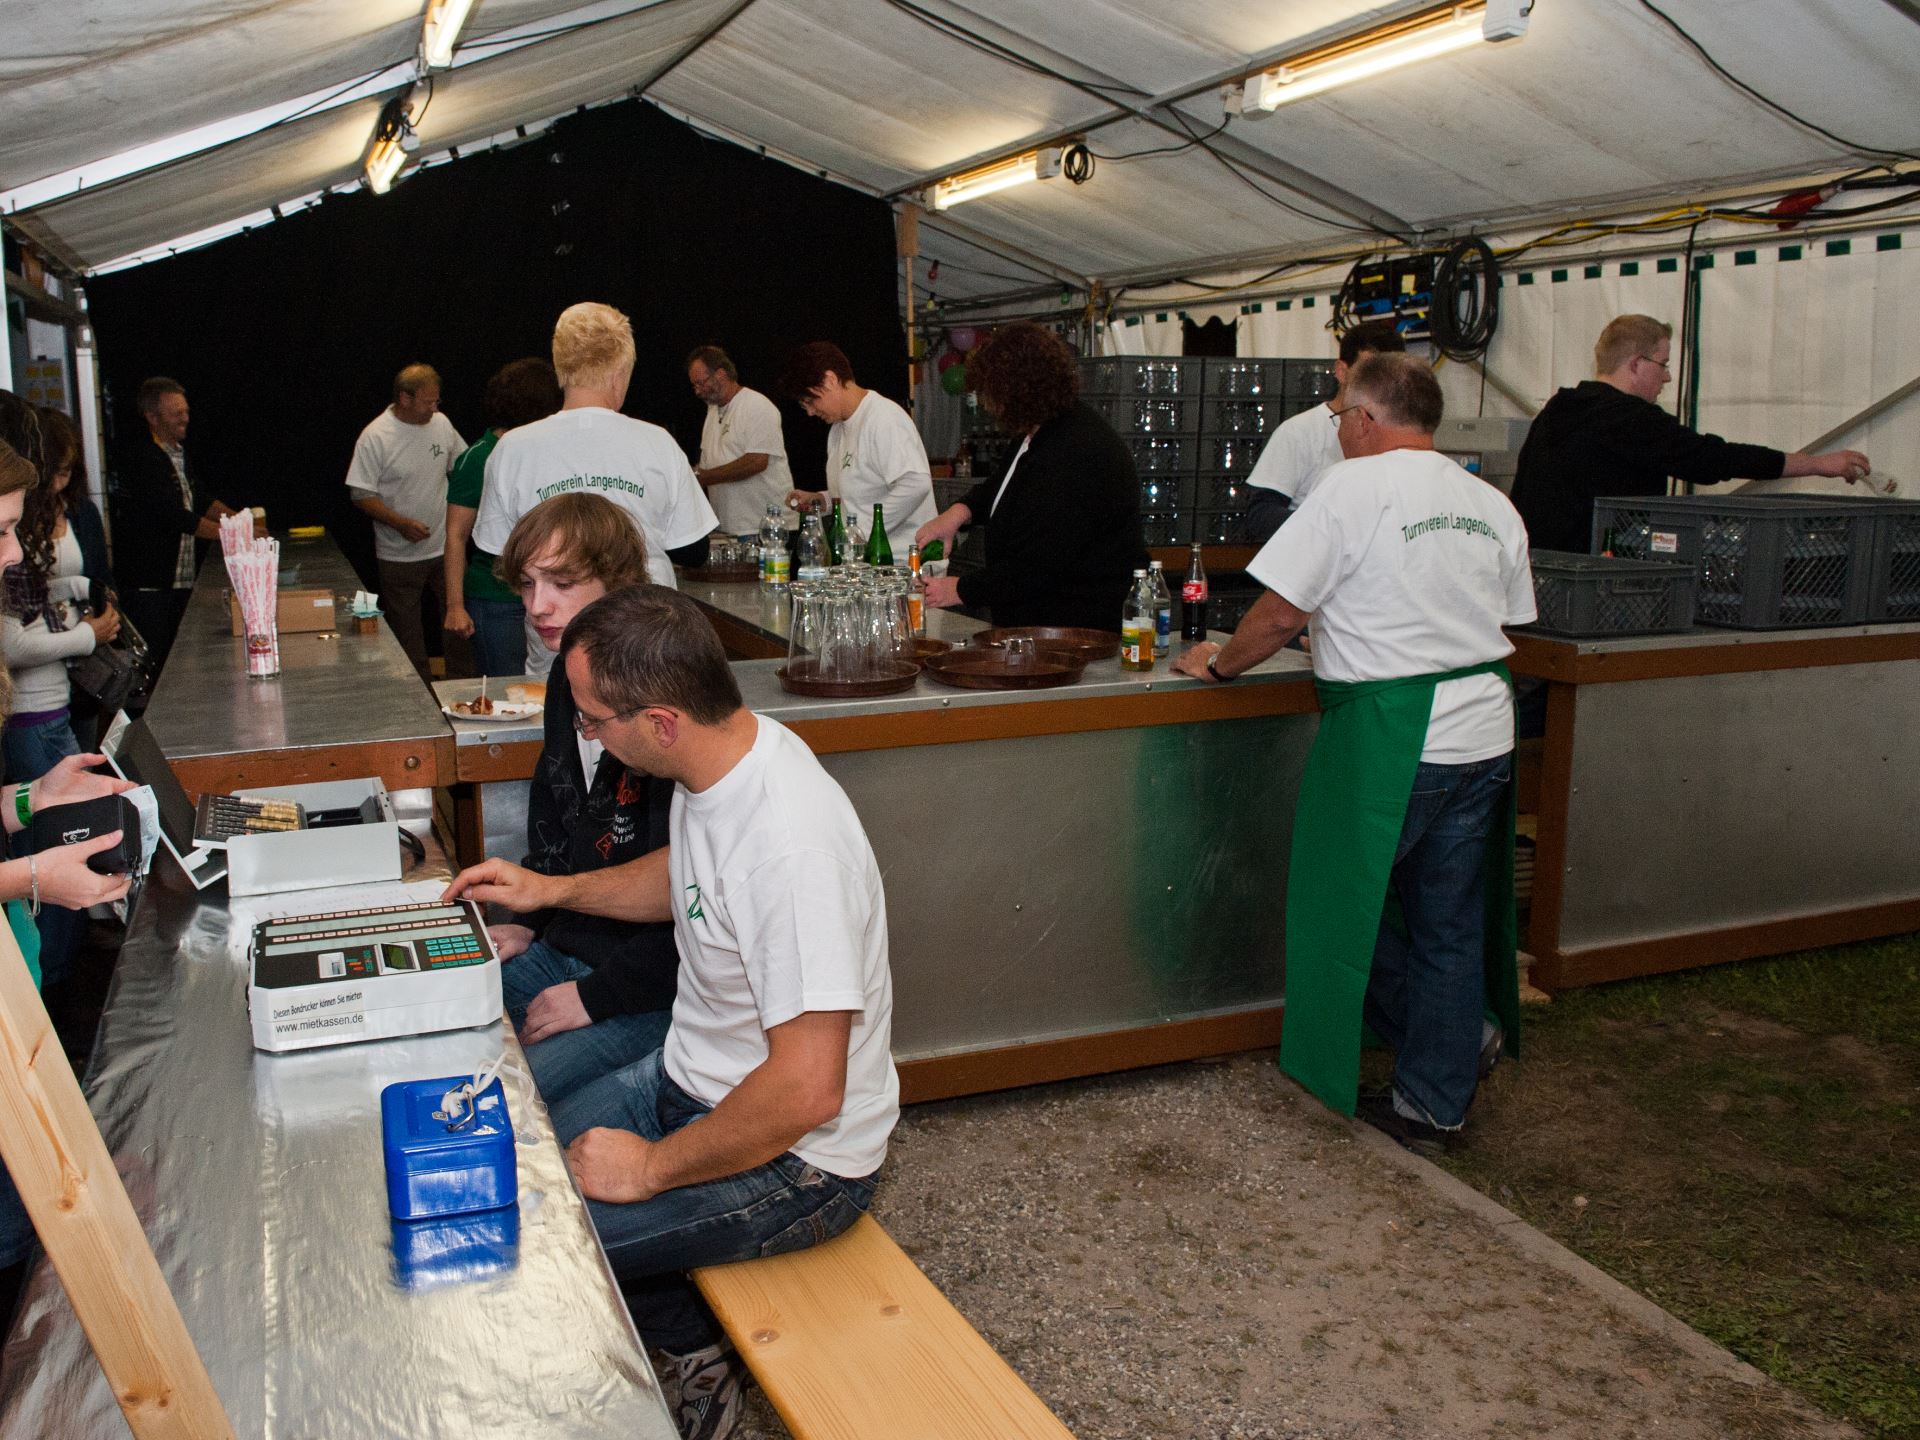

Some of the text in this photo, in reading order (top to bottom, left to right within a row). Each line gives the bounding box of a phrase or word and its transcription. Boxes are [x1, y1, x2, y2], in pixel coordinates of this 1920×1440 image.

[536, 473, 644, 502] Turnverein Langenbrand
[1401, 512, 1449, 543] Turnverein
[273, 1009, 290, 1019] Diesen
[291, 1001, 318, 1015] Bondrucker
[337, 994, 345, 1004] Sie
[345, 992, 362, 1002] mieten
[276, 1013, 363, 1033] www.mietkassen.de
